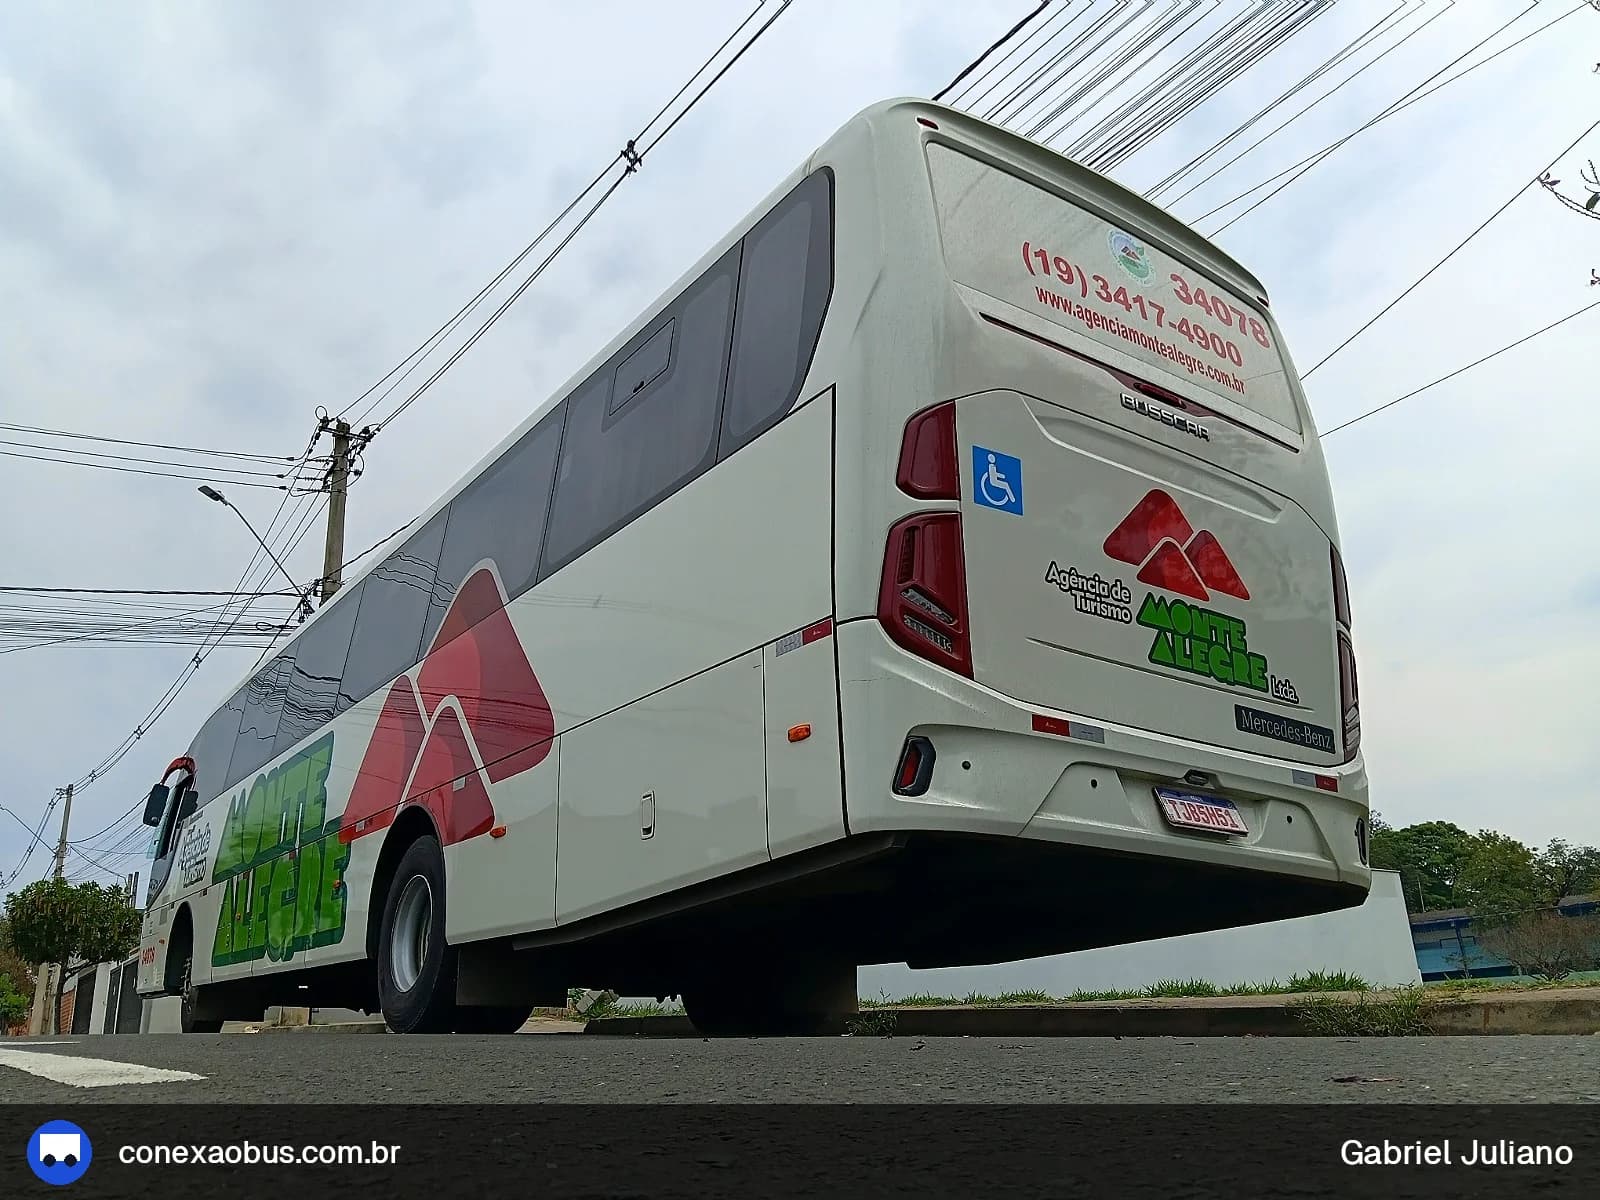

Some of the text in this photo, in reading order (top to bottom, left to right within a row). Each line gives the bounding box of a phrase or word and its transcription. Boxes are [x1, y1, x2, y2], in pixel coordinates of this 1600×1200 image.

[1170, 273, 1270, 348] 34078
[1035, 286, 1245, 394] www.agenciamontealegre.com.br
[1120, 392, 1209, 441] BUSSCAR
[1045, 561, 1132, 604] Agência de
[1071, 589, 1132, 624] Turismo
[1137, 593, 1246, 650] MONTE
[1149, 630, 1268, 692] ALEGRE
[1241, 710, 1332, 749] Mercedes-Benz
[1168, 800, 1238, 828] TJB5H51
